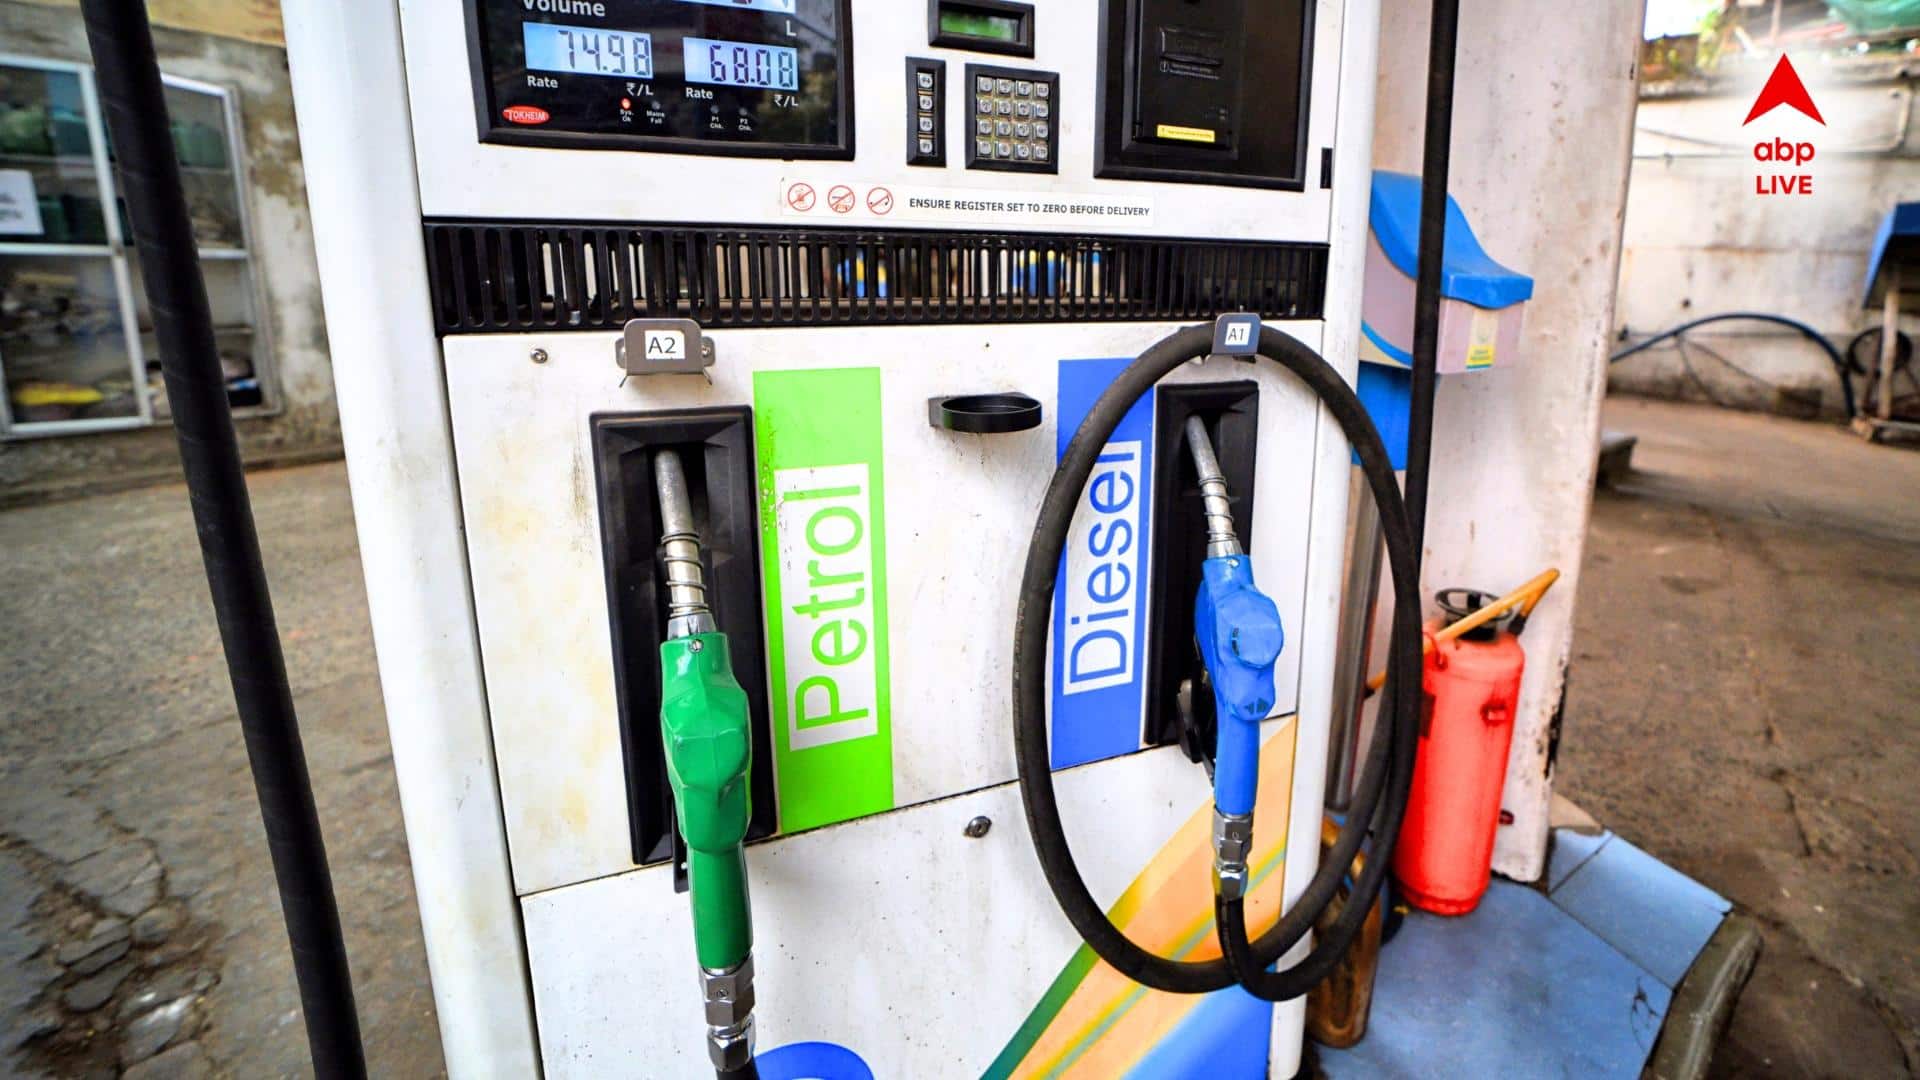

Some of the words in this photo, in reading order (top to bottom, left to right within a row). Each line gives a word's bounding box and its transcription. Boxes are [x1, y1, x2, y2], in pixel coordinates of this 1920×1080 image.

[523, 0, 605, 17] Volume
[786, 20, 797, 37] L
[558, 30, 650, 76] 74.98
[710, 44, 793, 88] 68.08
[527, 75, 558, 88] Rate
[626, 82, 654, 97] ₹/L
[685, 87, 713, 100] Rate
[773, 94, 799, 108] ₹/L
[503, 109, 547, 121] TOKHEIM
[909, 198, 951, 209] ENSURE
[954, 200, 1004, 211] REGISTER
[1007, 202, 1025, 212] SET
[1027, 203, 1040, 213] TO
[1042, 204, 1068, 214] ZERO
[1070, 204, 1104, 215] BEFORE
[1107, 206, 1150, 216] DELIVERY
[1228, 328, 1244, 341] A1
[648, 336, 677, 354] A2
[1070, 449, 1135, 684] Diesel
[784, 485, 869, 731] Petrol
